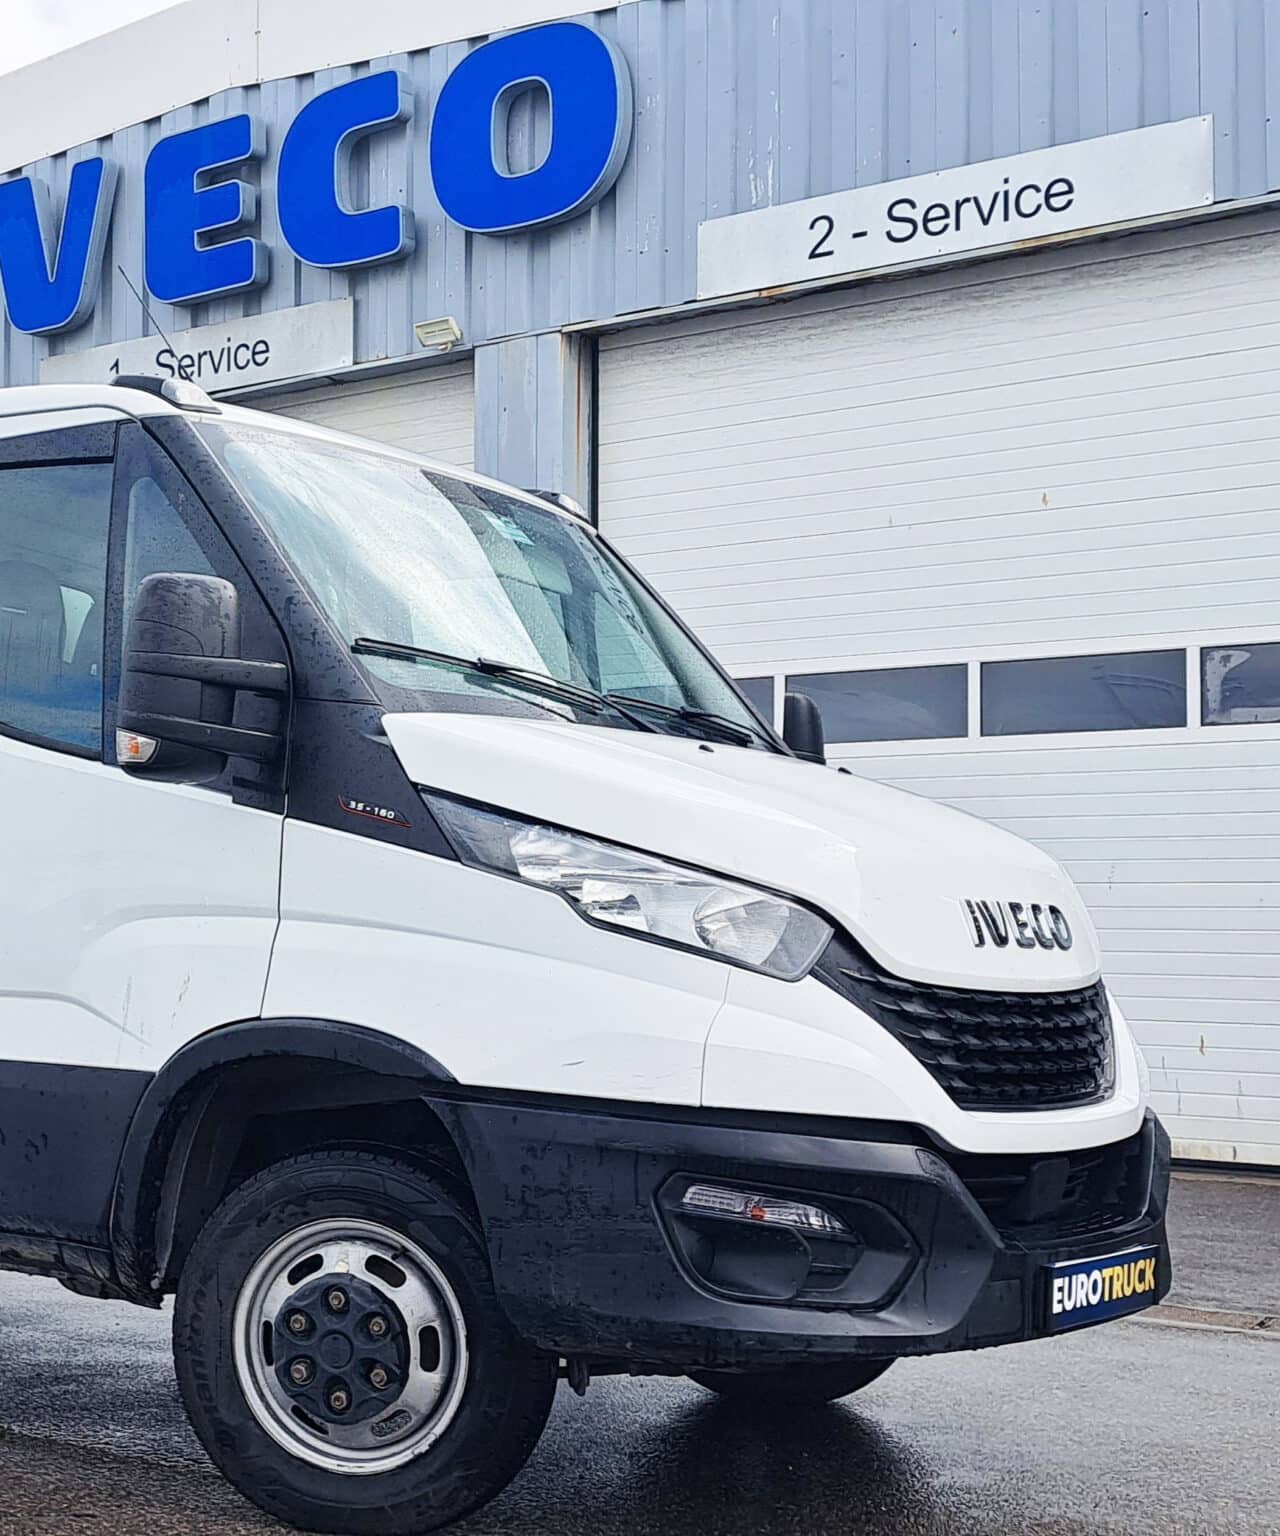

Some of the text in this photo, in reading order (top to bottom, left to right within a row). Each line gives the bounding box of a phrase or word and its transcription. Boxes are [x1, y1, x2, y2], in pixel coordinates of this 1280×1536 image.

[808, 214, 835, 260] 2
[884, 176, 1075, 244] Service
[155, 336, 271, 382] Service
[961, 898, 1073, 951] IVECO
[1051, 1256, 1156, 1315] EUROTRUCK
